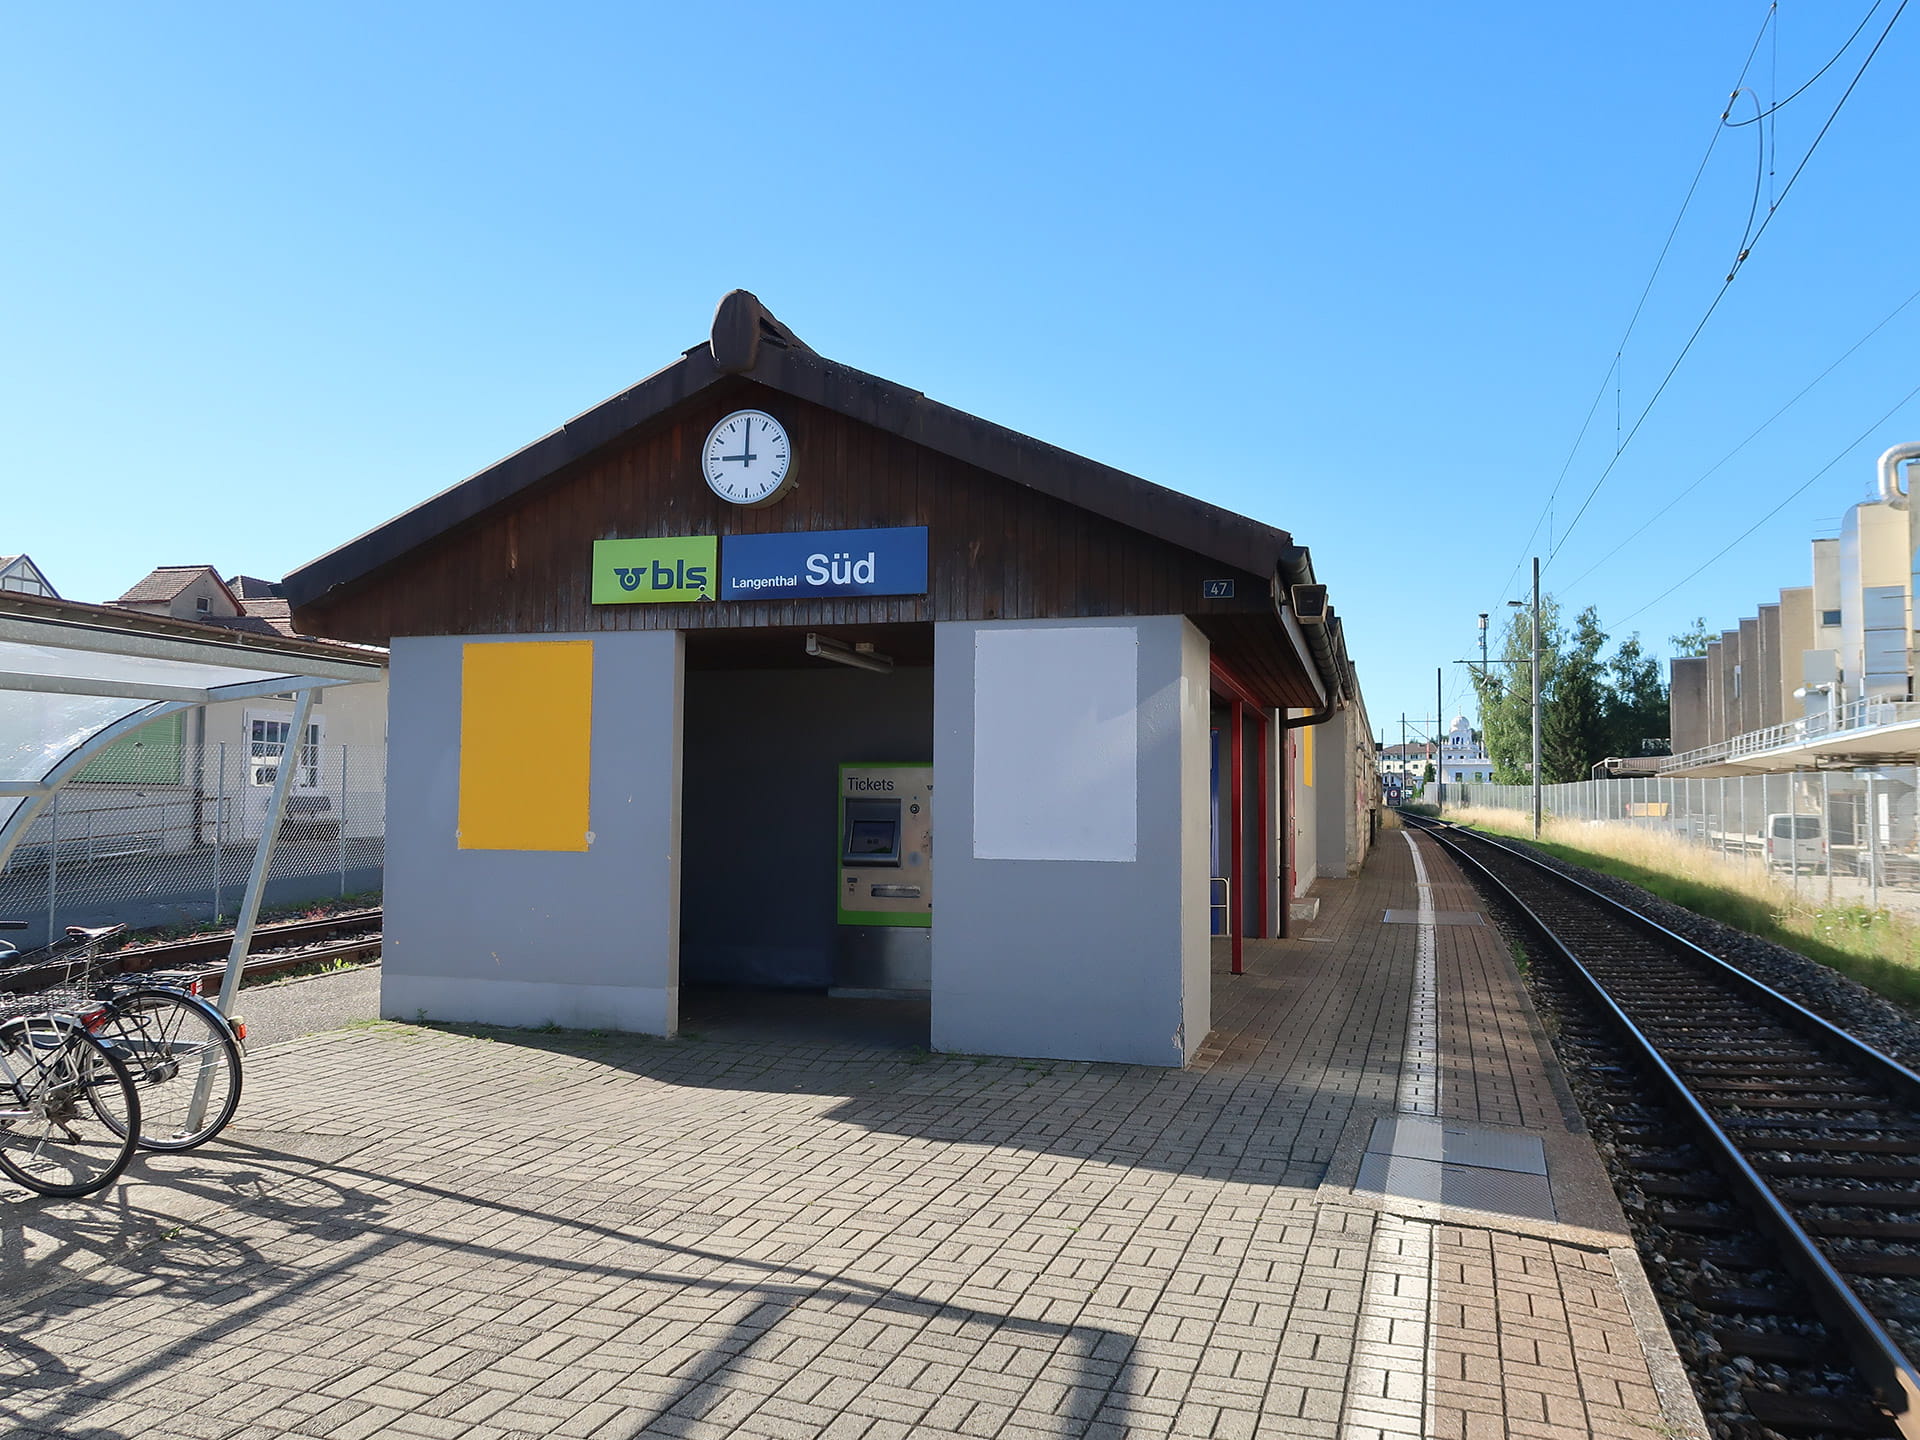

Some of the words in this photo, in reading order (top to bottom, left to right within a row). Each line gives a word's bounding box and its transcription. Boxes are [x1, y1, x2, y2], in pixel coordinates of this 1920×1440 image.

[651, 559, 708, 590] bls
[731, 574, 798, 590] Langenthal
[805, 551, 876, 586] Süd
[1210, 582, 1228, 595] 47
[847, 777, 895, 791] Tickets
